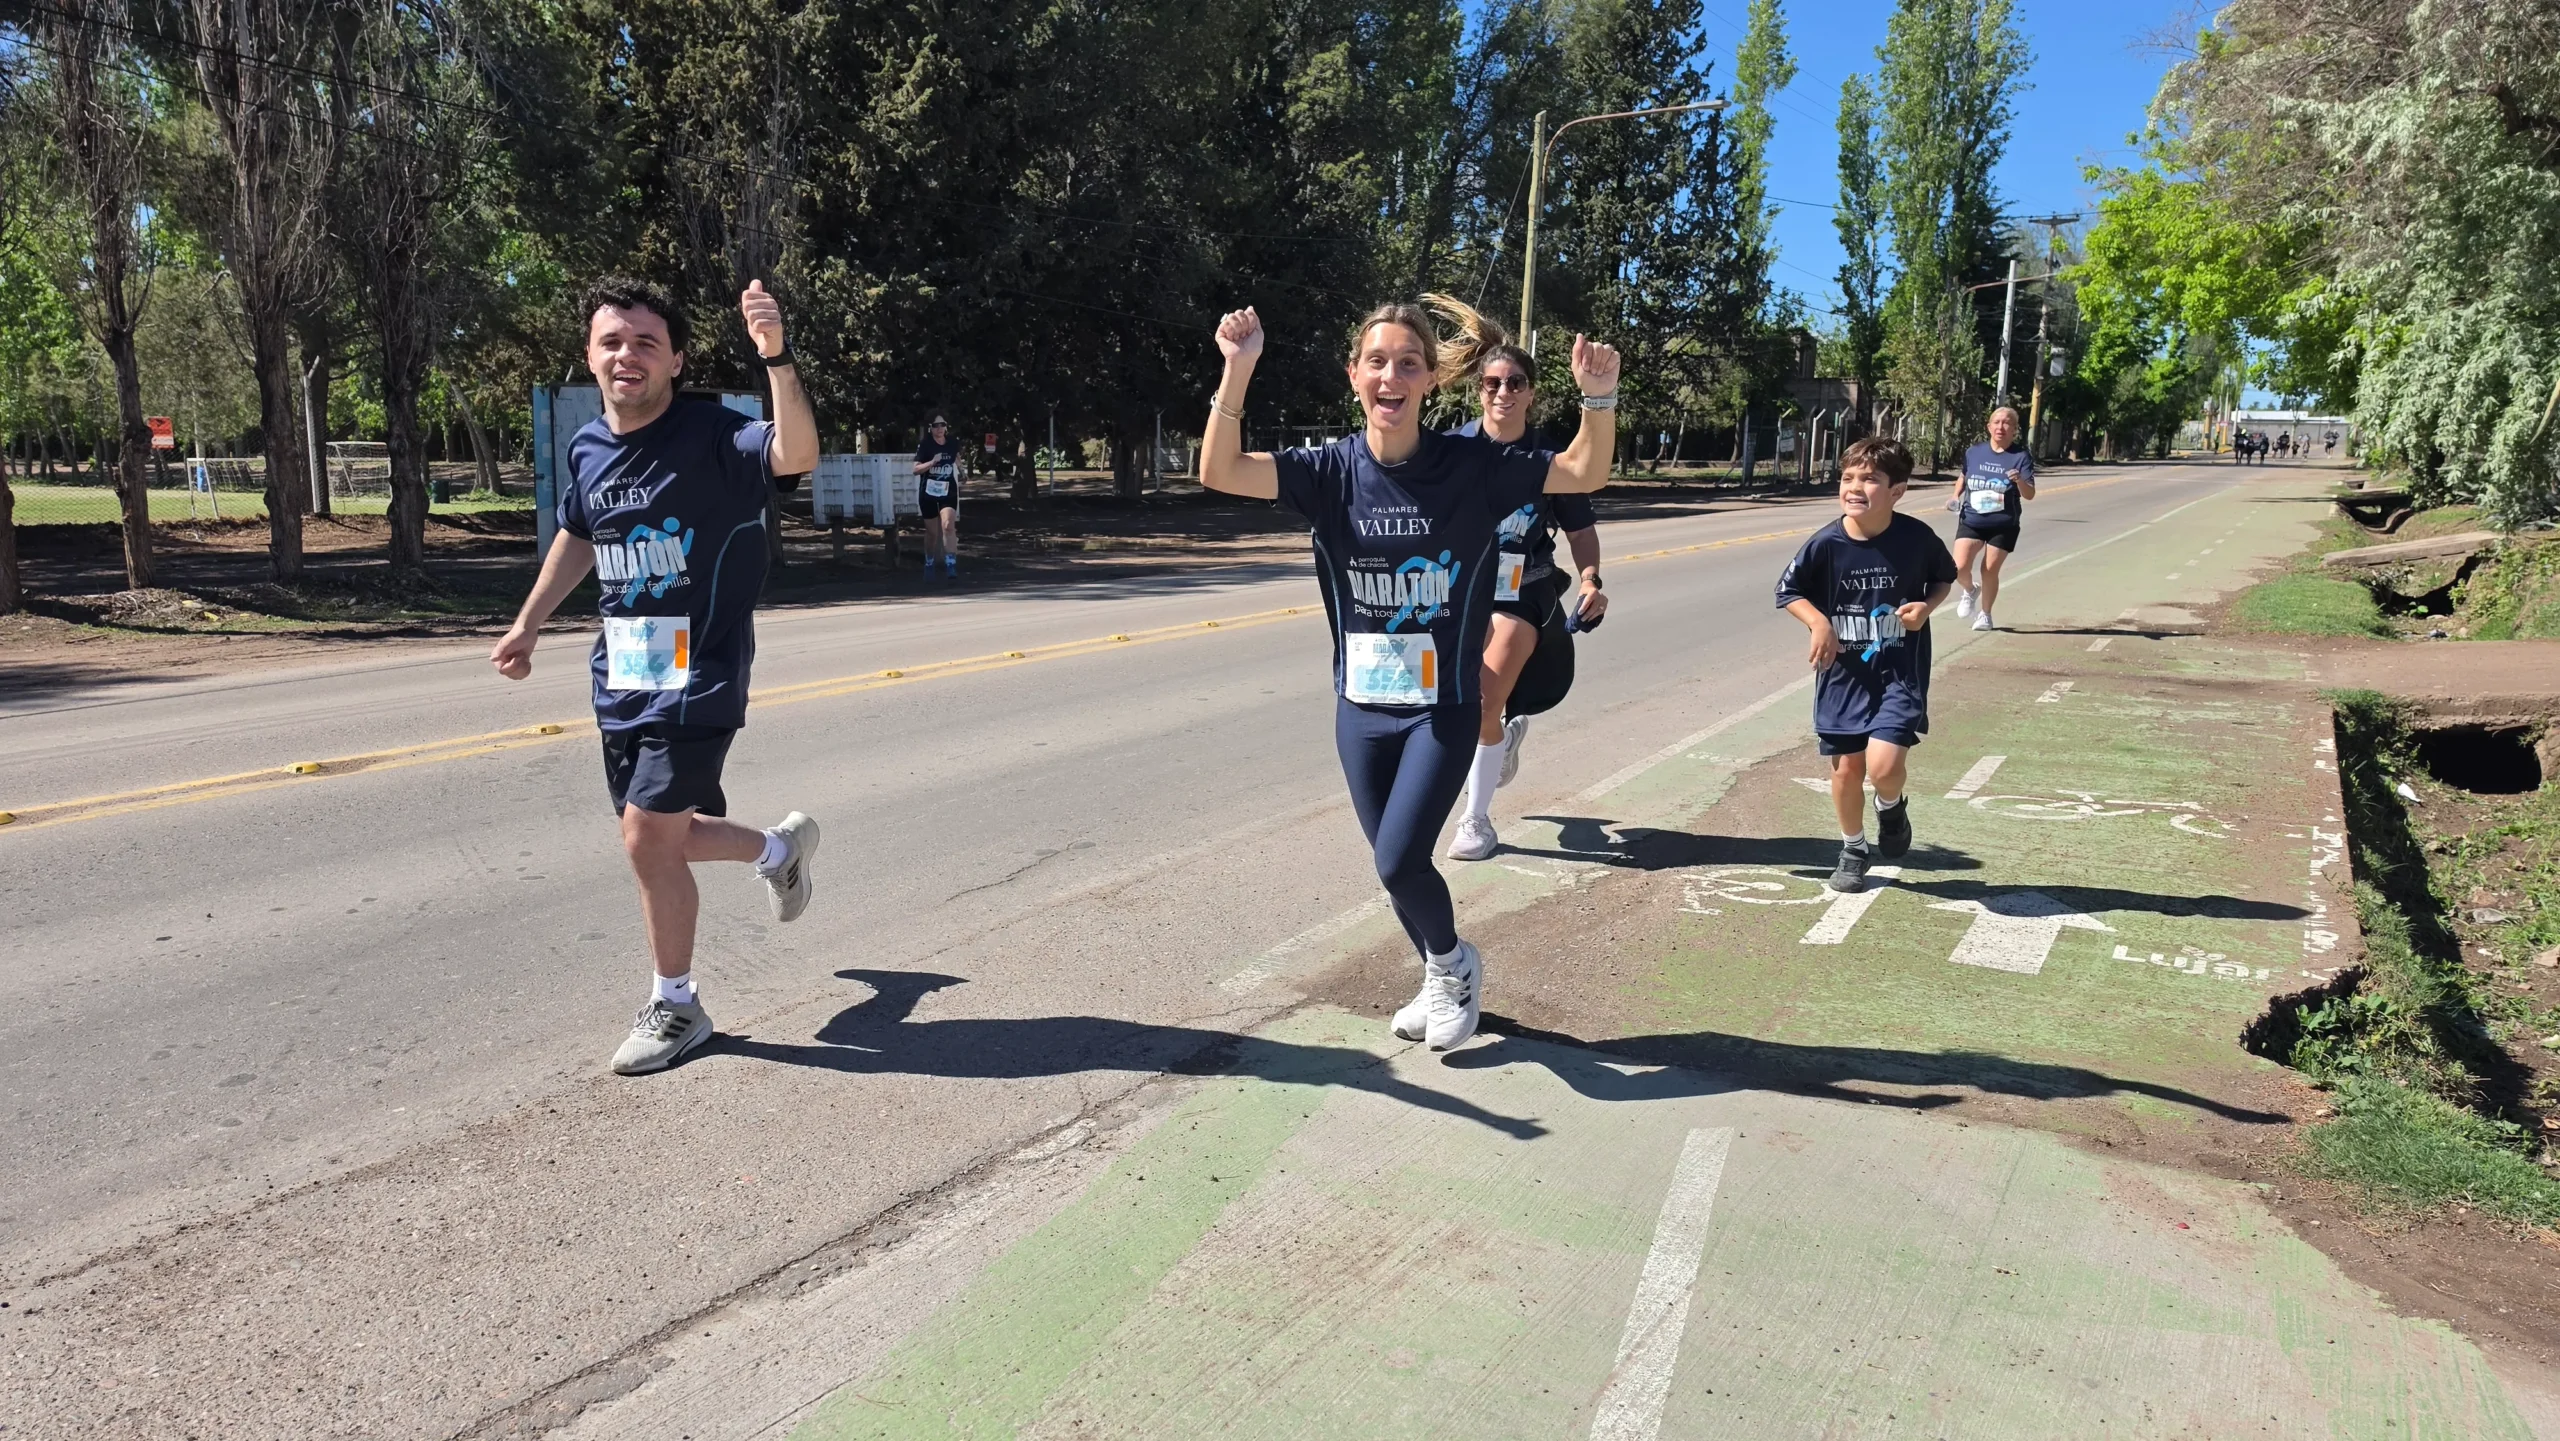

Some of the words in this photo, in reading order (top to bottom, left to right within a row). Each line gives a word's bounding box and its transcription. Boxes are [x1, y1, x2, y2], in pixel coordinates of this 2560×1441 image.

[589, 486, 651, 510] VALLEY
[1372, 506, 1418, 514] PALMARES
[1358, 518, 1433, 536] VALLEY
[1851, 567, 1887, 575] PALMARES
[635, 582, 646, 593] la
[647, 576, 691, 591] familia
[1346, 562, 1450, 607] MARATÓN
[1841, 576, 1898, 591] VALLEY
[1354, 604, 1373, 618] para
[1374, 608, 1401, 620] toda
[1402, 609, 1413, 619] la
[1414, 606, 1451, 620] familia
[1852, 642, 1873, 651] toda
